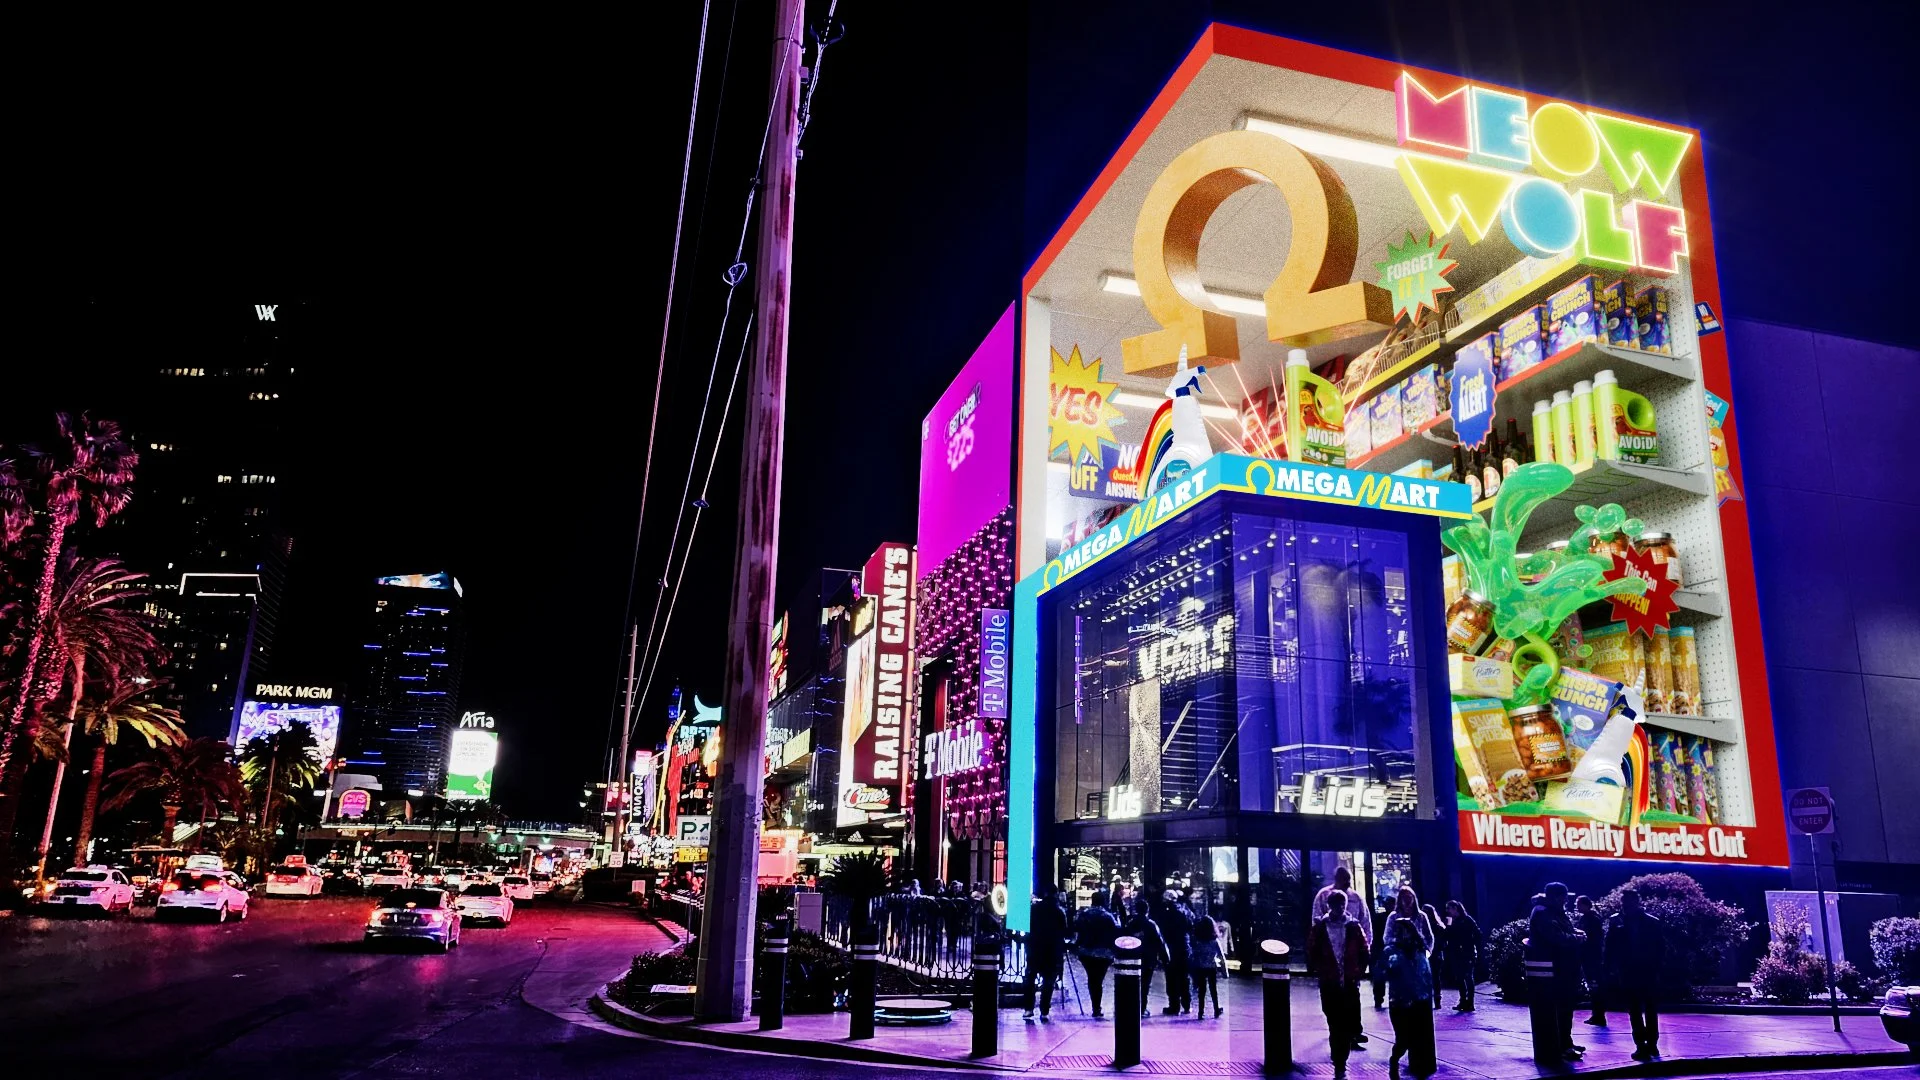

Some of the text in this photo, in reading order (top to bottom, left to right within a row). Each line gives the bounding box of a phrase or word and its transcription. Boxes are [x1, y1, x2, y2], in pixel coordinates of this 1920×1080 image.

[1395, 70, 1693, 199] MEOW
[1393, 150, 1689, 273] WOLF
[1386, 251, 1435, 283] FORGET
[1050, 382, 1102, 427] YES
[1459, 384, 1487, 423] ALERT
[1104, 481, 1139, 500] ANSWE
[1123, 468, 1209, 542] MART
[1354, 473, 1441, 508] MART
[873, 547, 909, 780] RAISING CANE'S
[255, 684, 333, 699] PARK MGM
[459, 711, 495, 729] Aria
[1107, 783, 1143, 820] Lids
[1300, 773, 1387, 818] Lids
[1807, 797, 1823, 805] NOT
[1472, 813, 1748, 859] Where Reality Checks Out
[1799, 816, 1824, 825] ENTER
